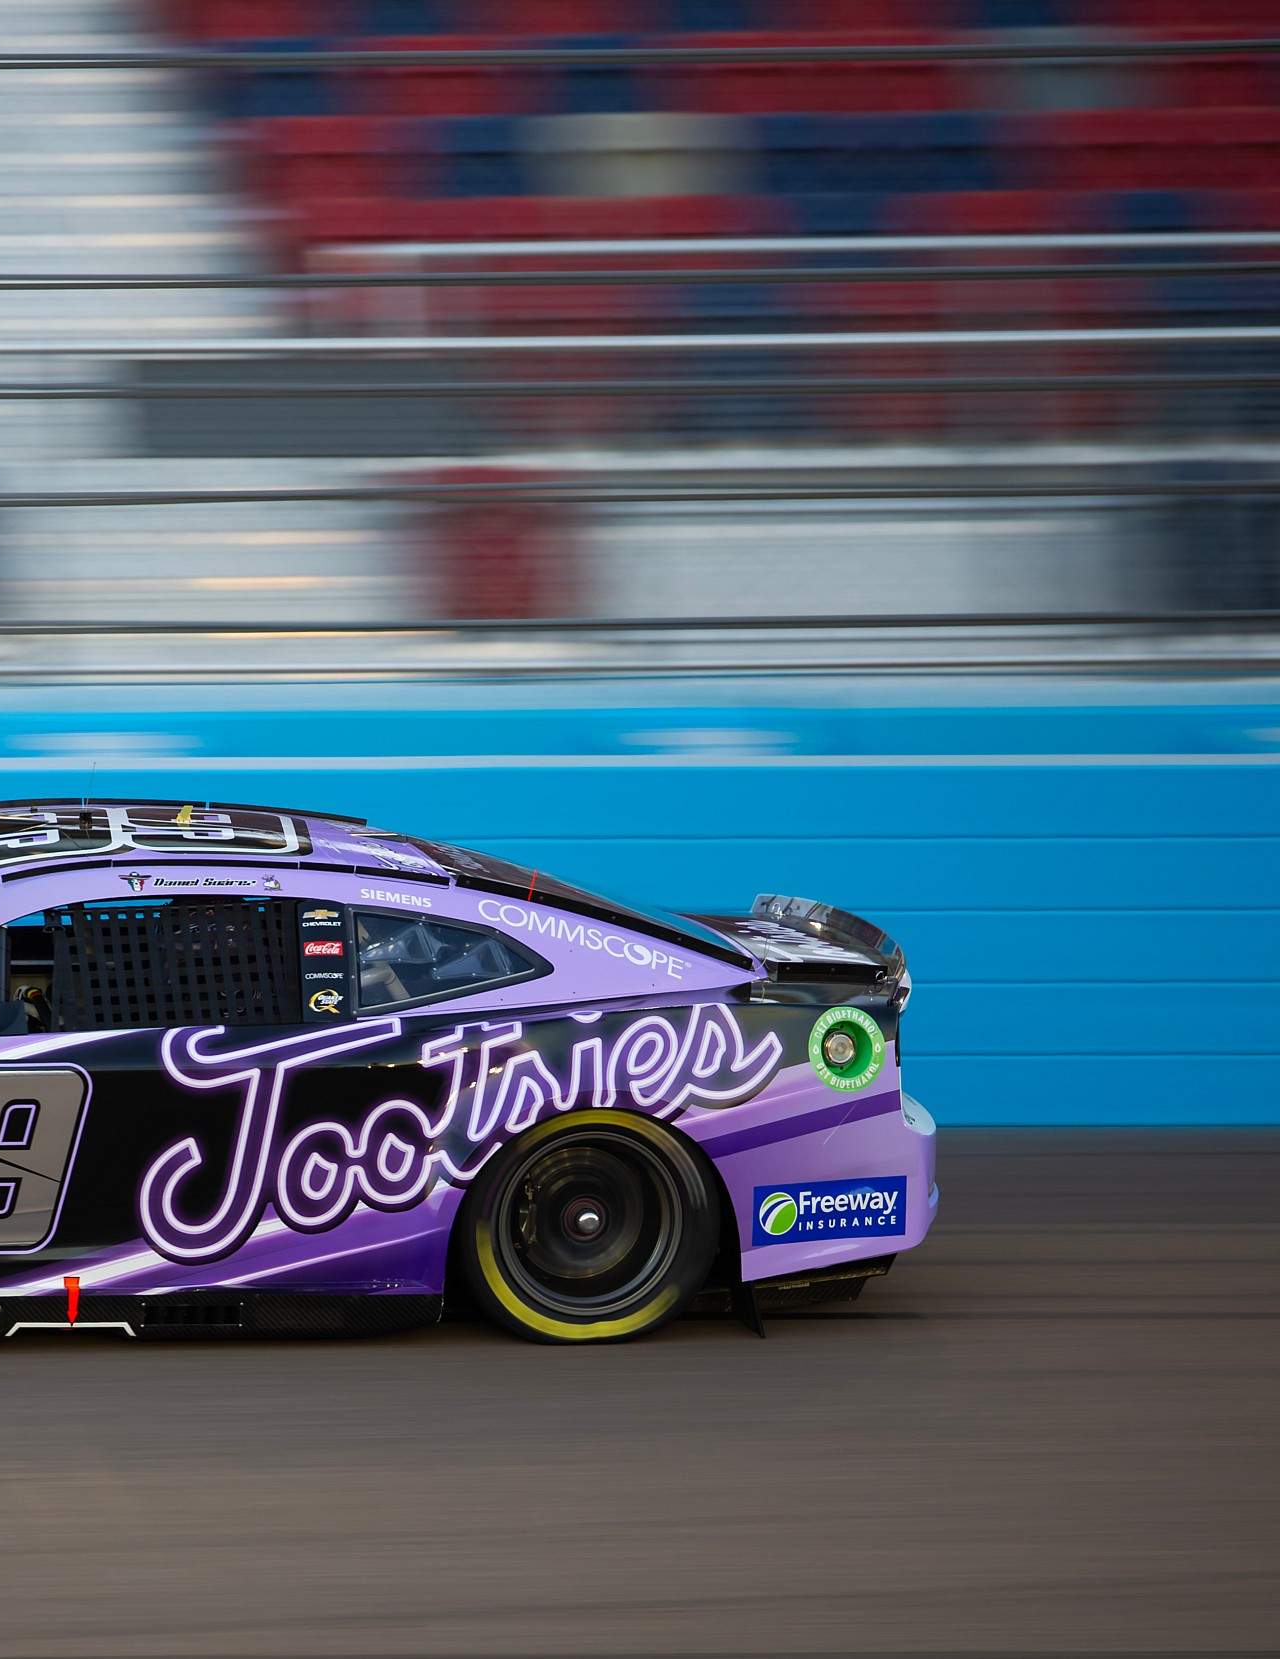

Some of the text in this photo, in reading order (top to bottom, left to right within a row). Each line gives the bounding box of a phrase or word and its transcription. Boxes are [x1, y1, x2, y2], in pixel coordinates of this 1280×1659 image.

[360, 888, 432, 908] SIEMENS
[814, 1010, 878, 1038] GET BIOETHANOL
[816, 1062, 880, 1089] GET BIOETHANOL
[799, 1191, 898, 1215] Freeway
[798, 1215, 897, 1232] INSURANCE
